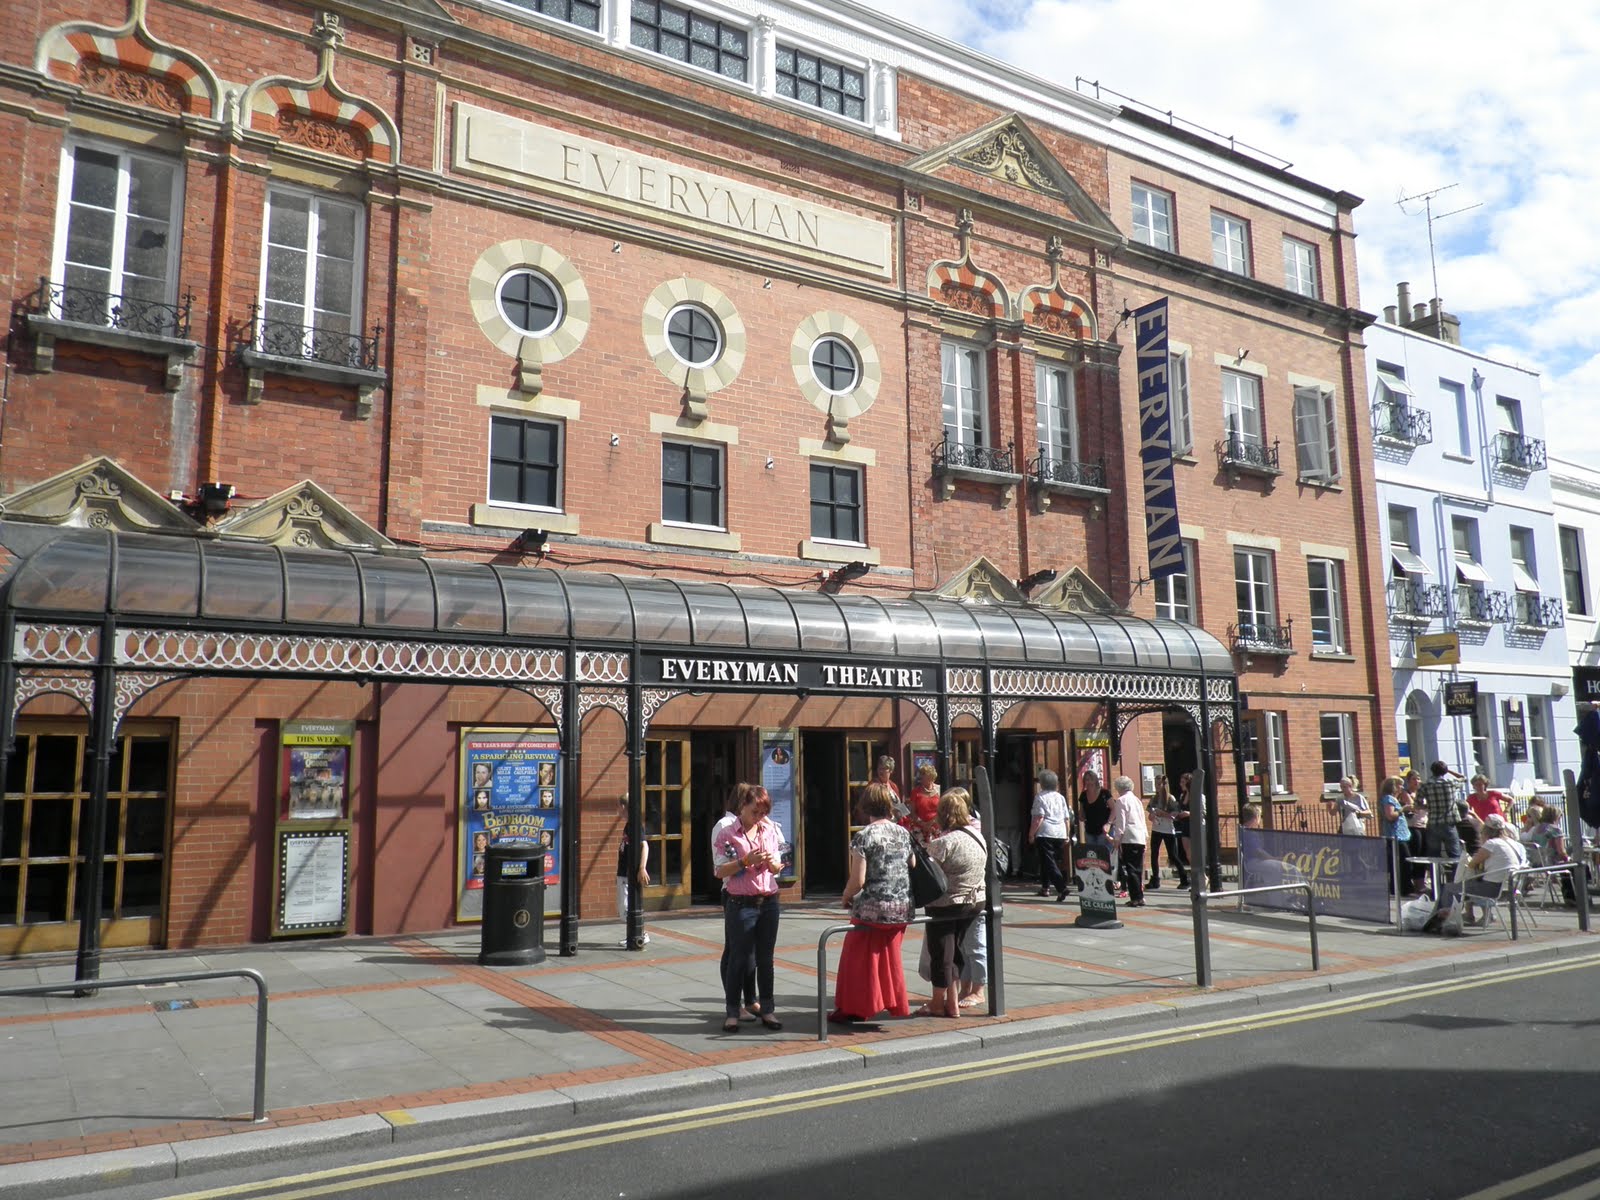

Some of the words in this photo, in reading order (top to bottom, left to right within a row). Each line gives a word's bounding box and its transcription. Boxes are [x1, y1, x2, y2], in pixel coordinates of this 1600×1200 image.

[560, 143, 822, 249] EVERYMAN
[1136, 305, 1183, 571] EVERYMAN
[662, 657, 799, 683] EVERYMAN
[823, 664, 923, 688] THEATRE
[1447, 698, 1474, 706] CENTRE
[1453, 692, 1467, 700] EYE
[296, 735, 315, 743] THIS
[316, 735, 340, 743] WEEK
[482, 811, 545, 830] BEDROOM
[490, 825, 539, 839] FARCE
[1281, 846, 1340, 880] café
[1081, 900, 1092, 908] ICE
[1092, 902, 1115, 911] CREAM
